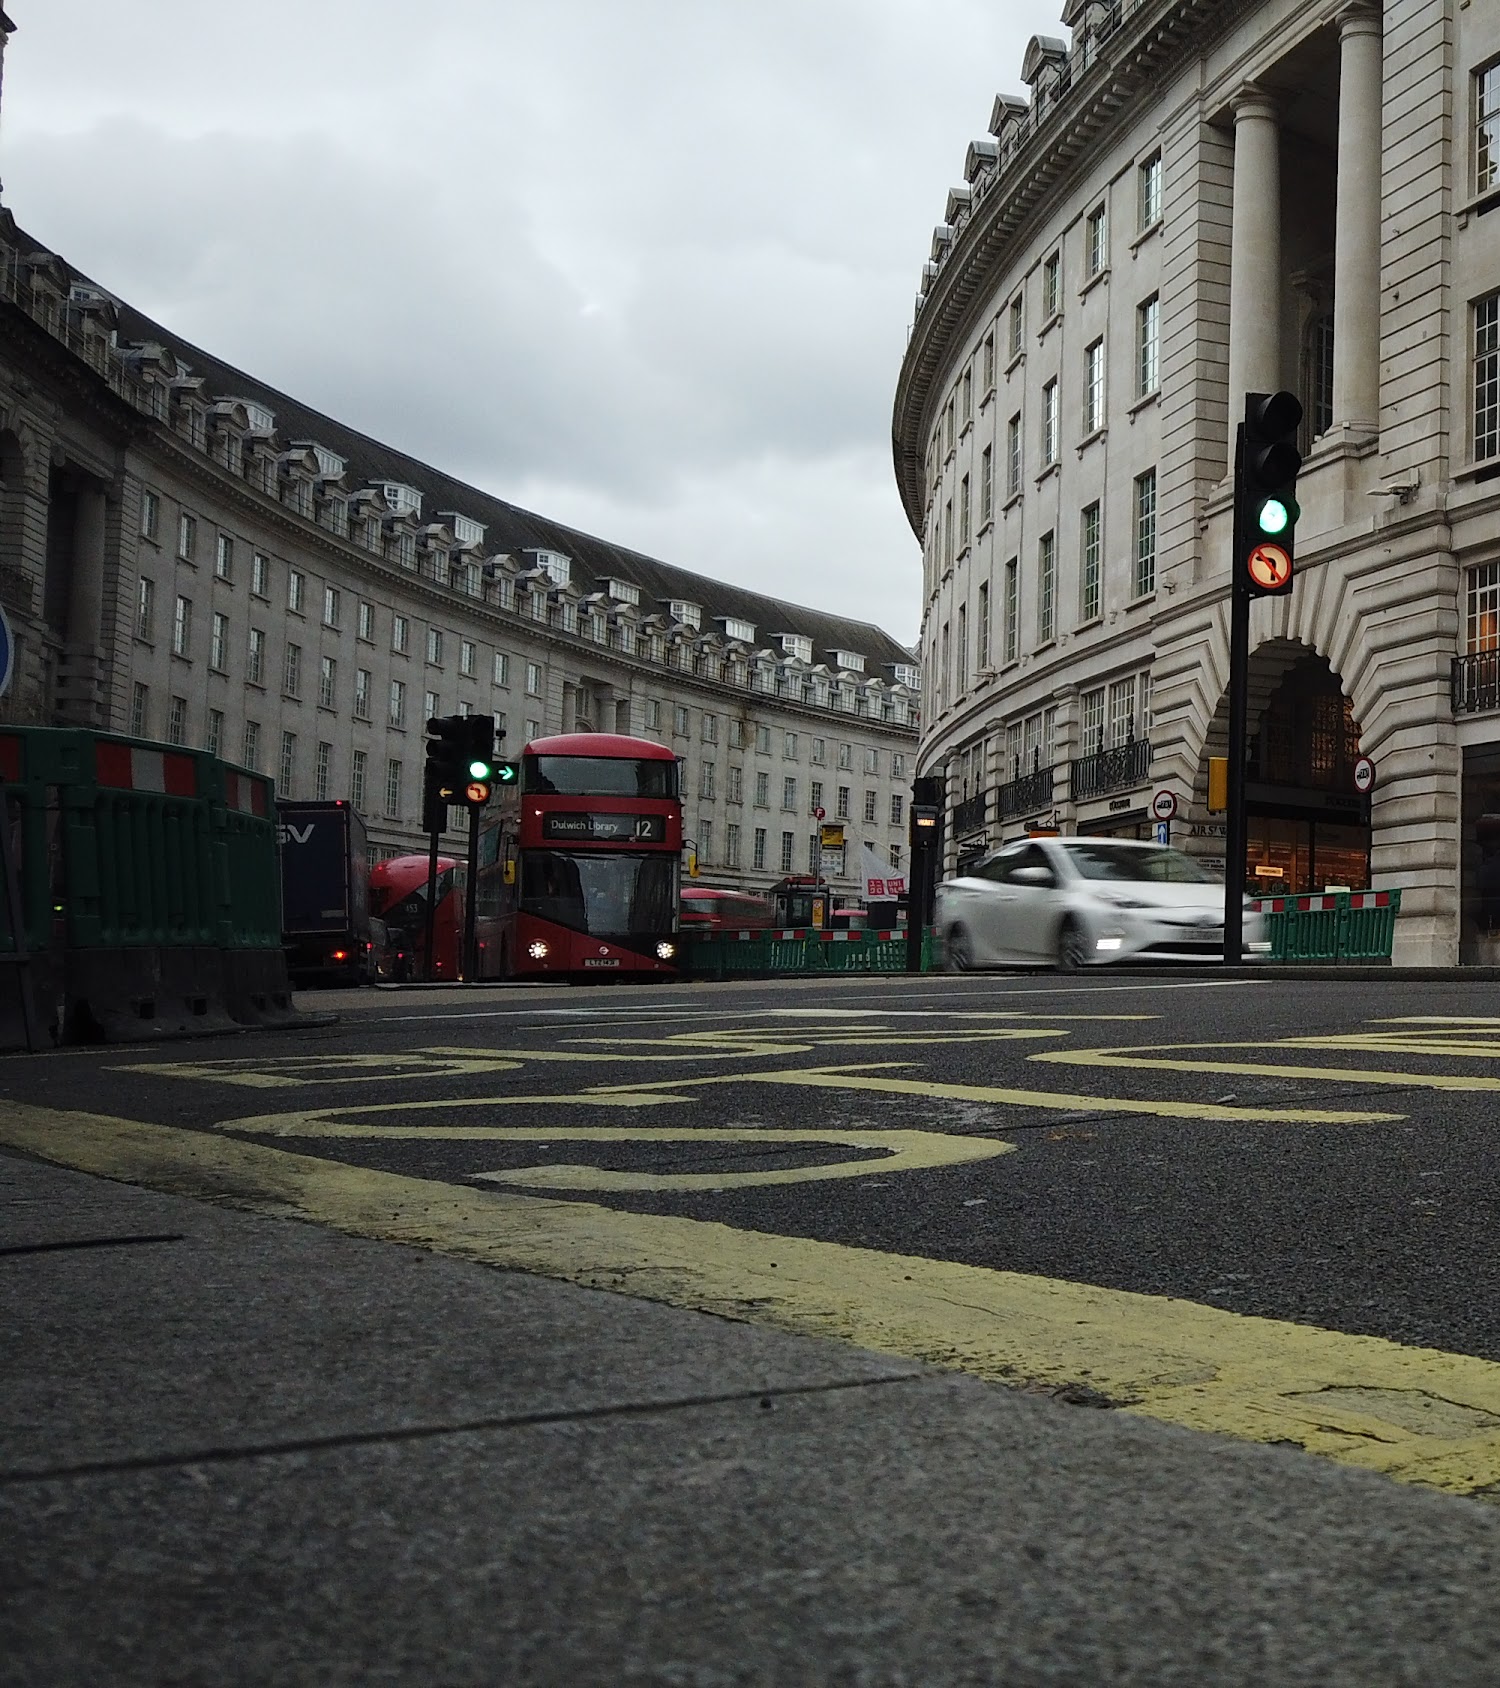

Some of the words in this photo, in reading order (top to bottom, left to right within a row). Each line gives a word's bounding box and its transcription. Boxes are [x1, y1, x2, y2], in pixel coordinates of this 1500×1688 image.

[275, 823, 316, 844] SV
[551, 819, 586, 831] Dulwich
[588, 821, 618, 834] Library
[636, 820, 652, 837] 12
[1191, 825, 1207, 835] AIR
